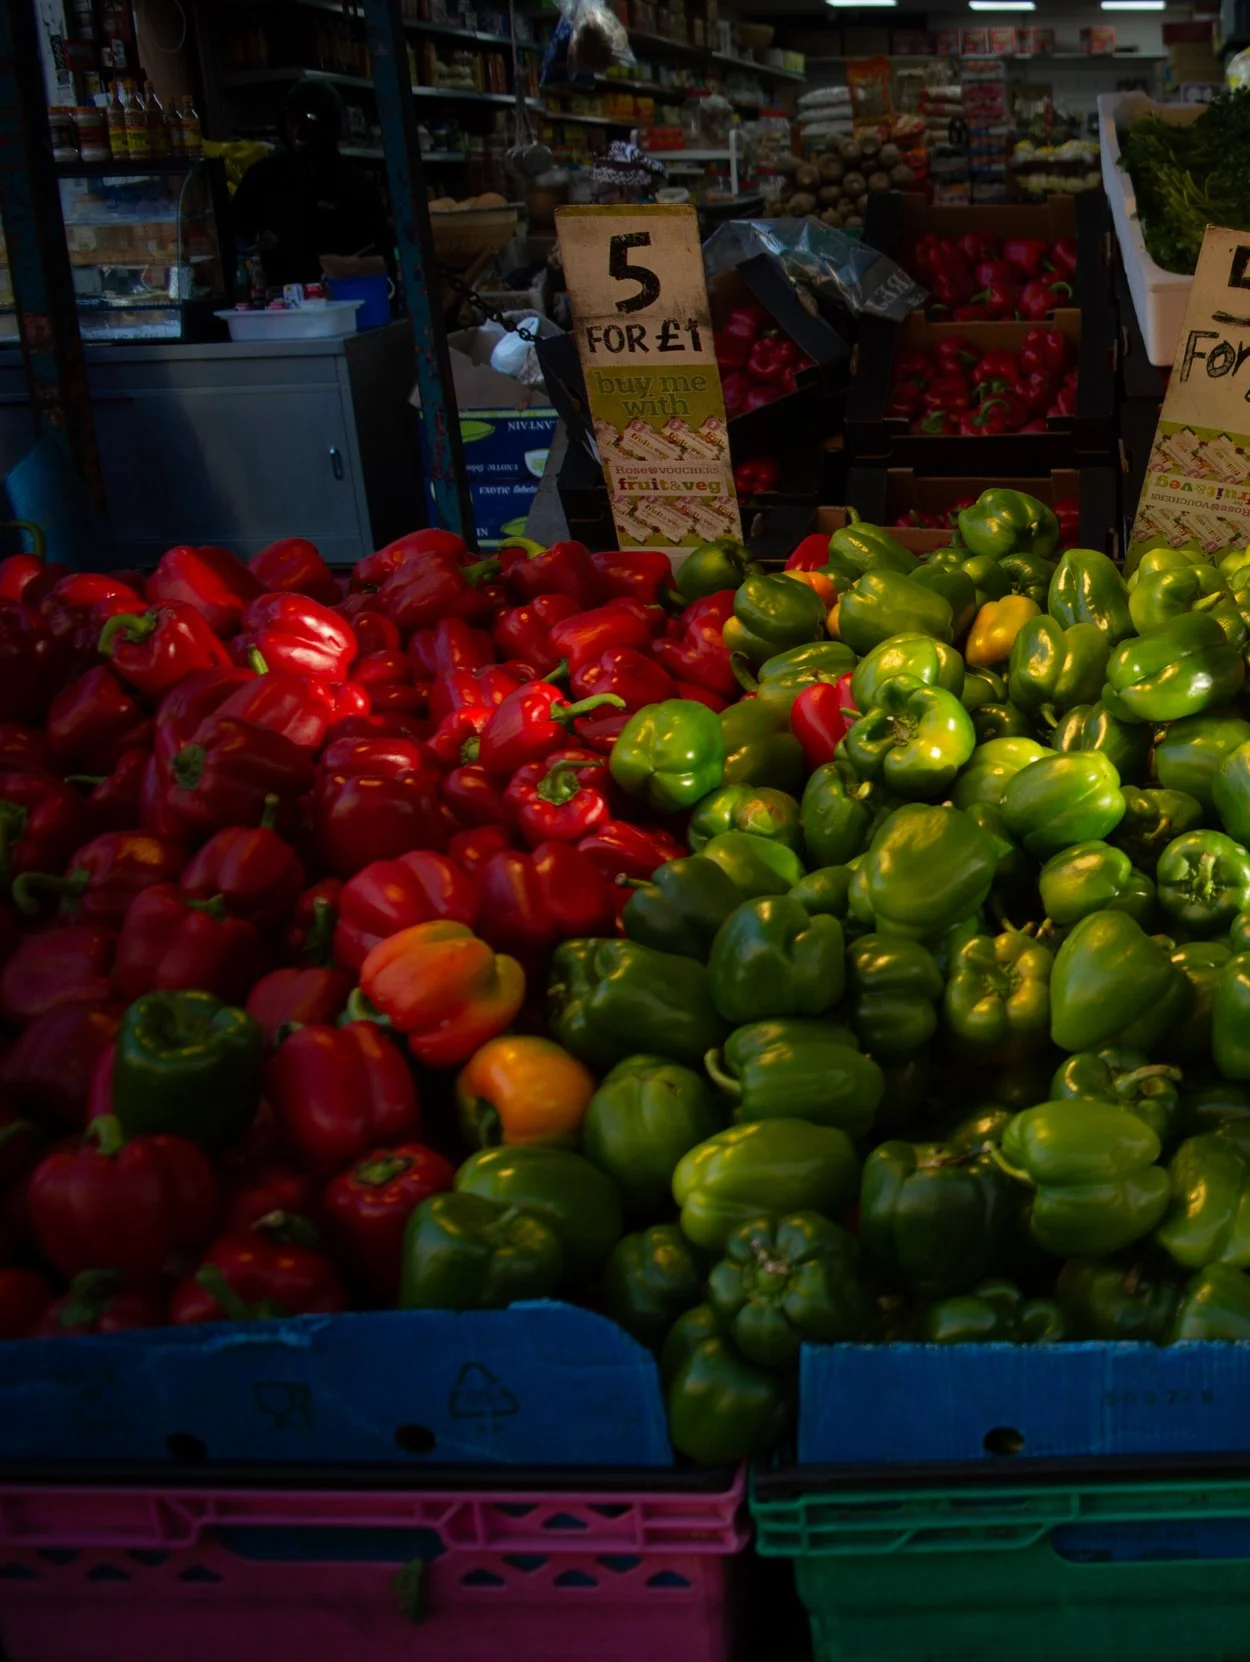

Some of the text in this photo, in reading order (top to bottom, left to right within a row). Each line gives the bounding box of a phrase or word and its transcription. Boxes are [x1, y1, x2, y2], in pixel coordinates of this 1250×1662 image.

[609, 231, 661, 314] 5
[586, 317, 703, 353] FOR £1
[593, 370, 708, 399] buy me
[622, 393, 691, 417] with
[479, 486, 511, 495] EXOTIC
